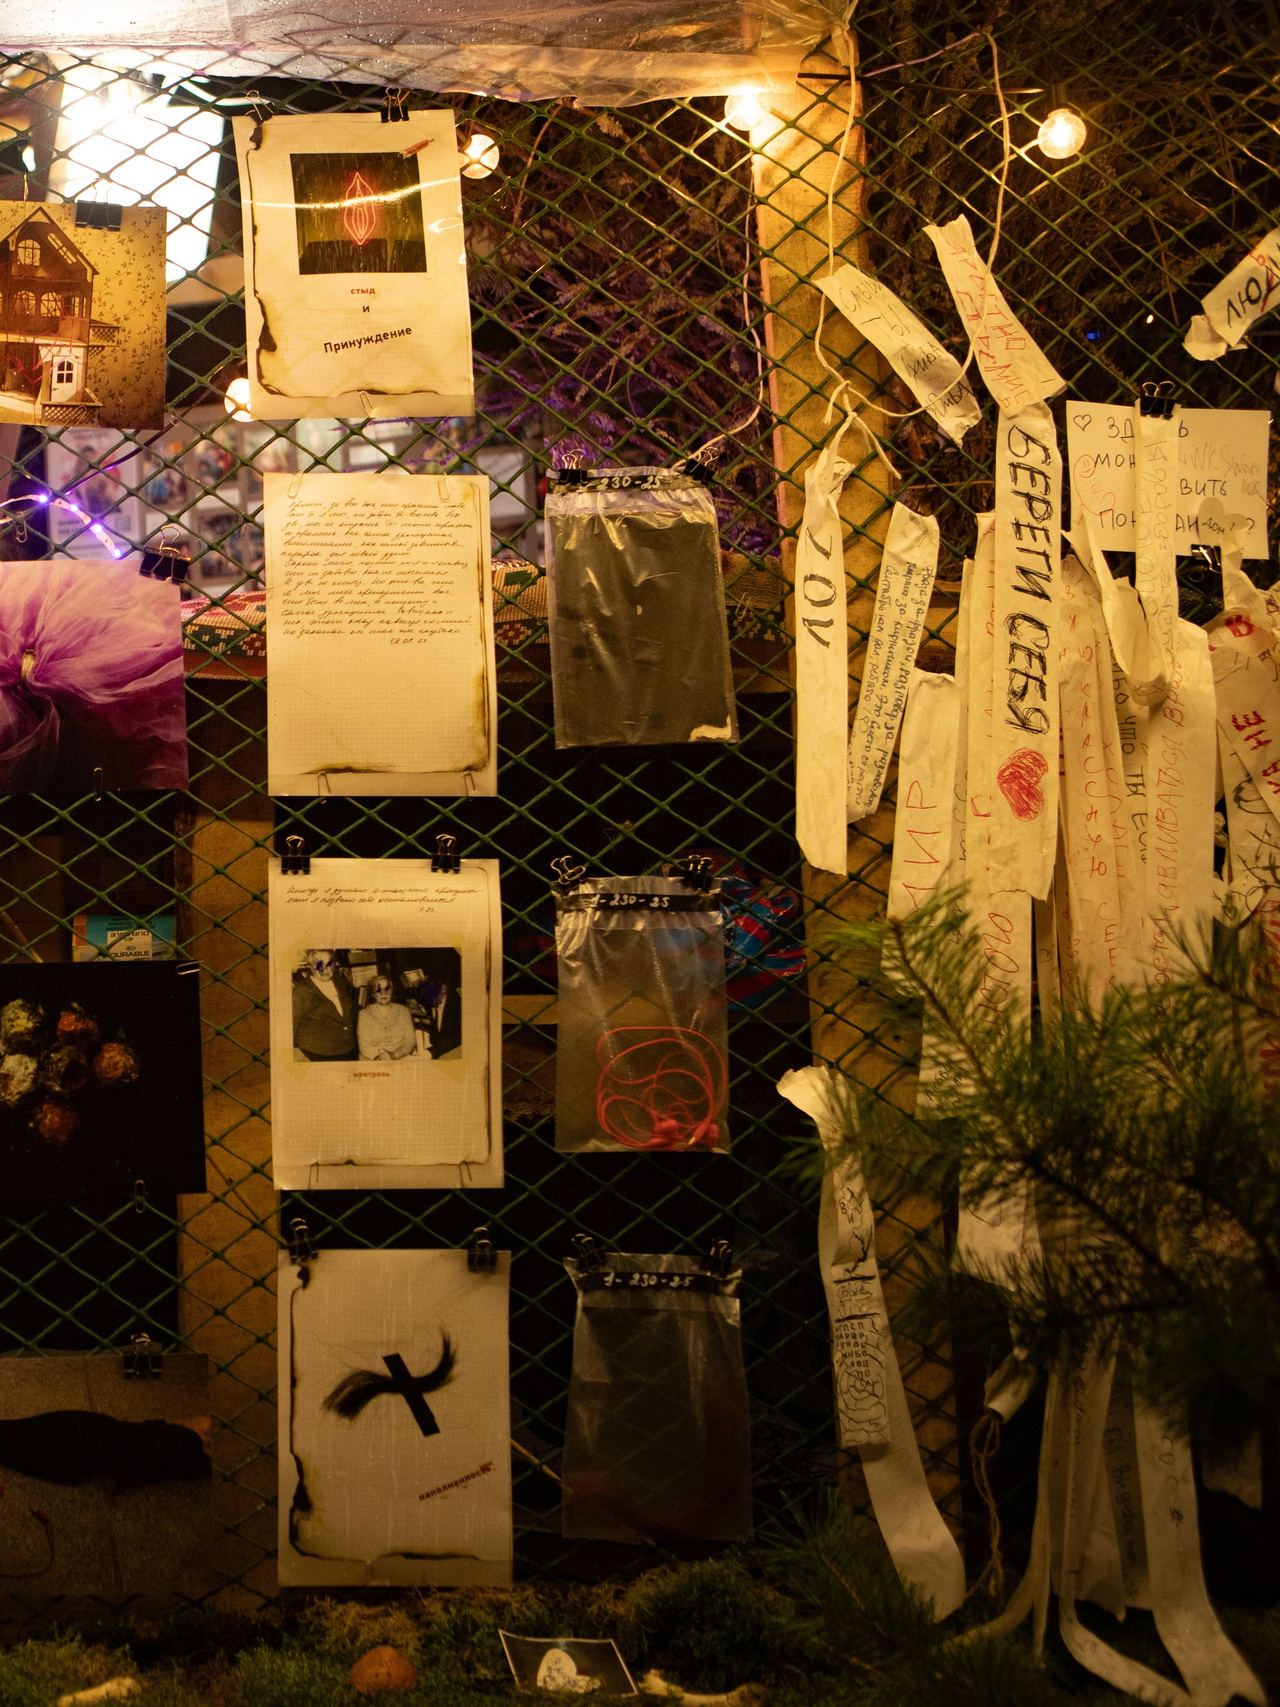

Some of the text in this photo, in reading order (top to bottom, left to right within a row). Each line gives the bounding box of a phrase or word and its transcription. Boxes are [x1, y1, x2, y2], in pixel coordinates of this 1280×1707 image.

[350, 286, 376, 296] стыд
[362, 305, 370, 314] и
[323, 325, 413, 354] Принуждение
[1002, 424, 1054, 735] БЕРЕГИ СЕБЯ
[110, 950, 150, 959] DURABLE
